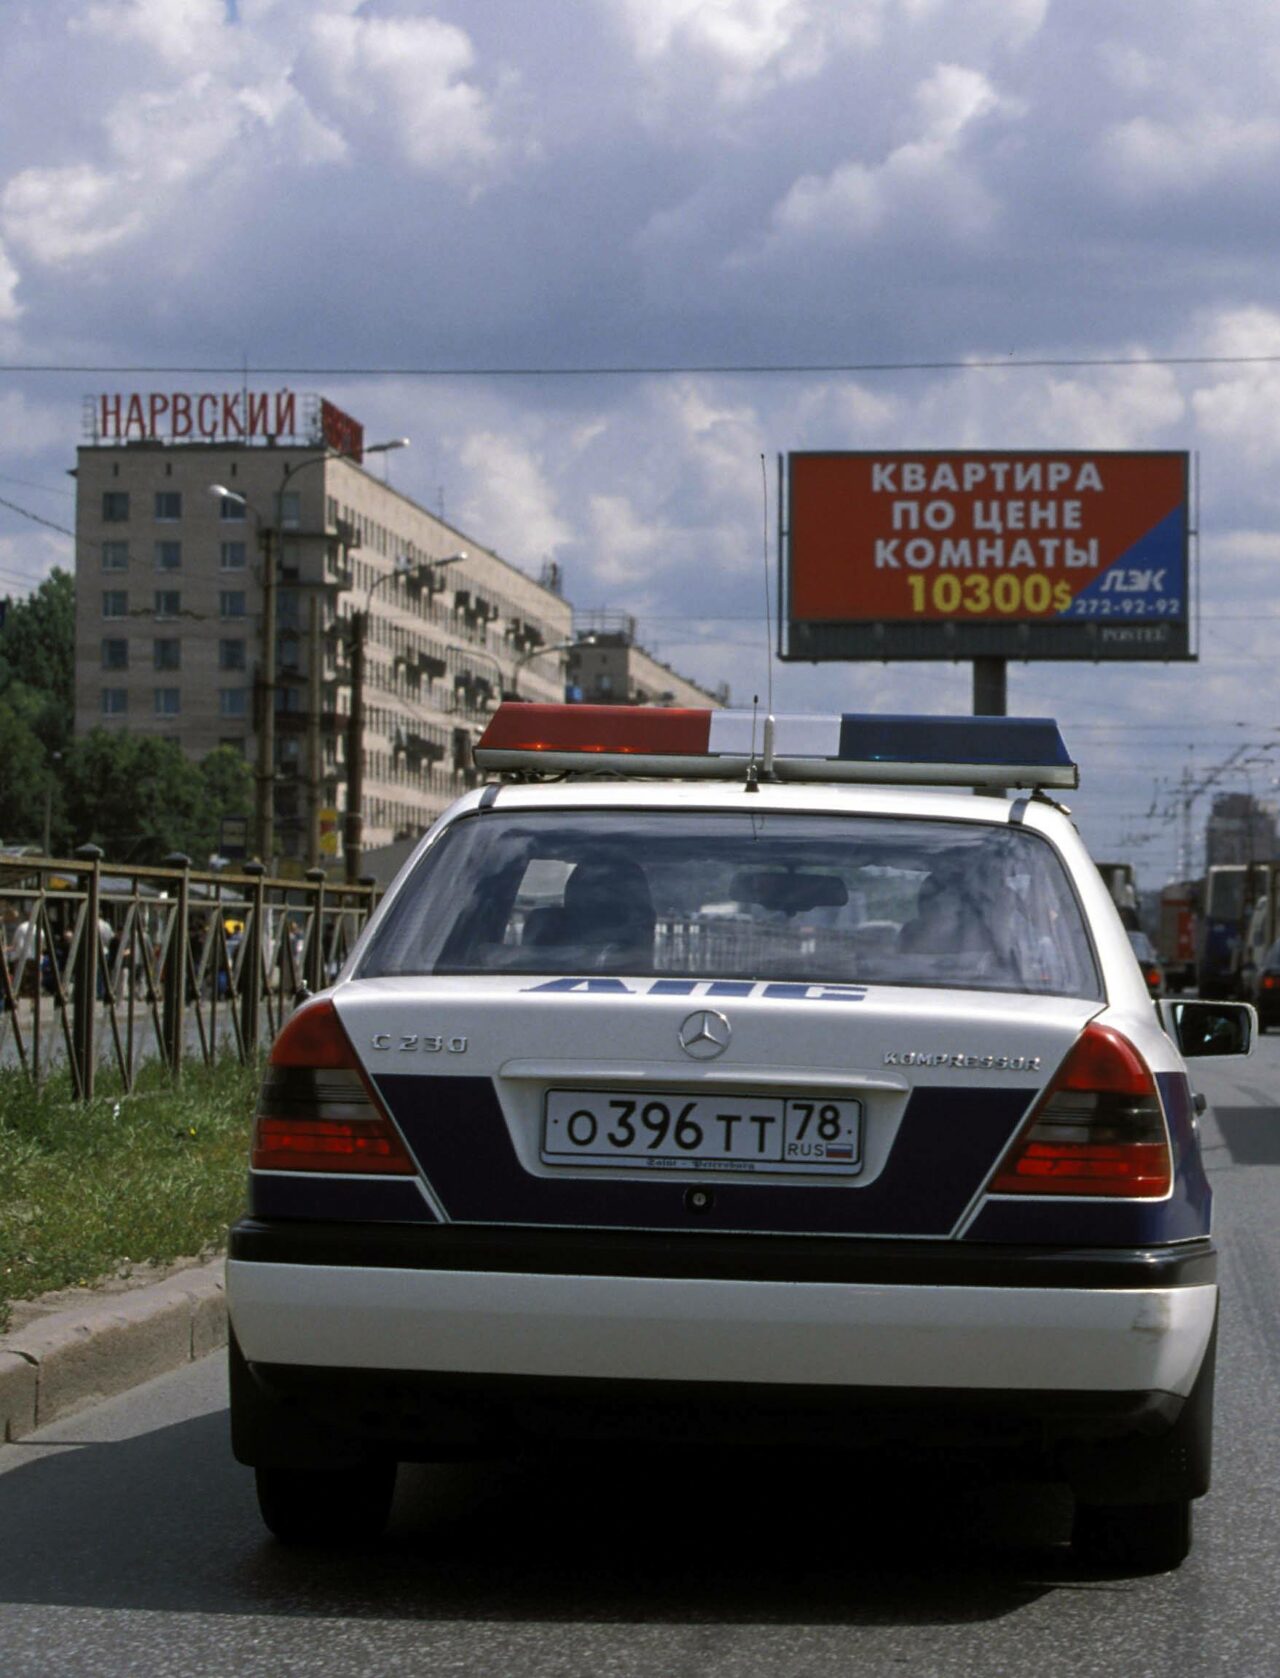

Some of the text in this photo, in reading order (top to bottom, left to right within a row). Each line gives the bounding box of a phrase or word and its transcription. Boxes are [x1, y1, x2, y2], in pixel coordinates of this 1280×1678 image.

[101, 387, 296, 438] НАРВСКИЙ
[871, 462, 1104, 492] КВАРТИРА
[892, 500, 1082, 534] ПО ЦЕНЕ
[874, 538, 1099, 569] КОМНАТЫ
[1074, 598, 1181, 615] 272-92-92
[370, 1034, 469, 1055] C 230
[883, 1051, 1042, 1072] KOMPRESSOR
[791, 1103, 841, 1142] 78
[786, 1143, 825, 1158] RUS
